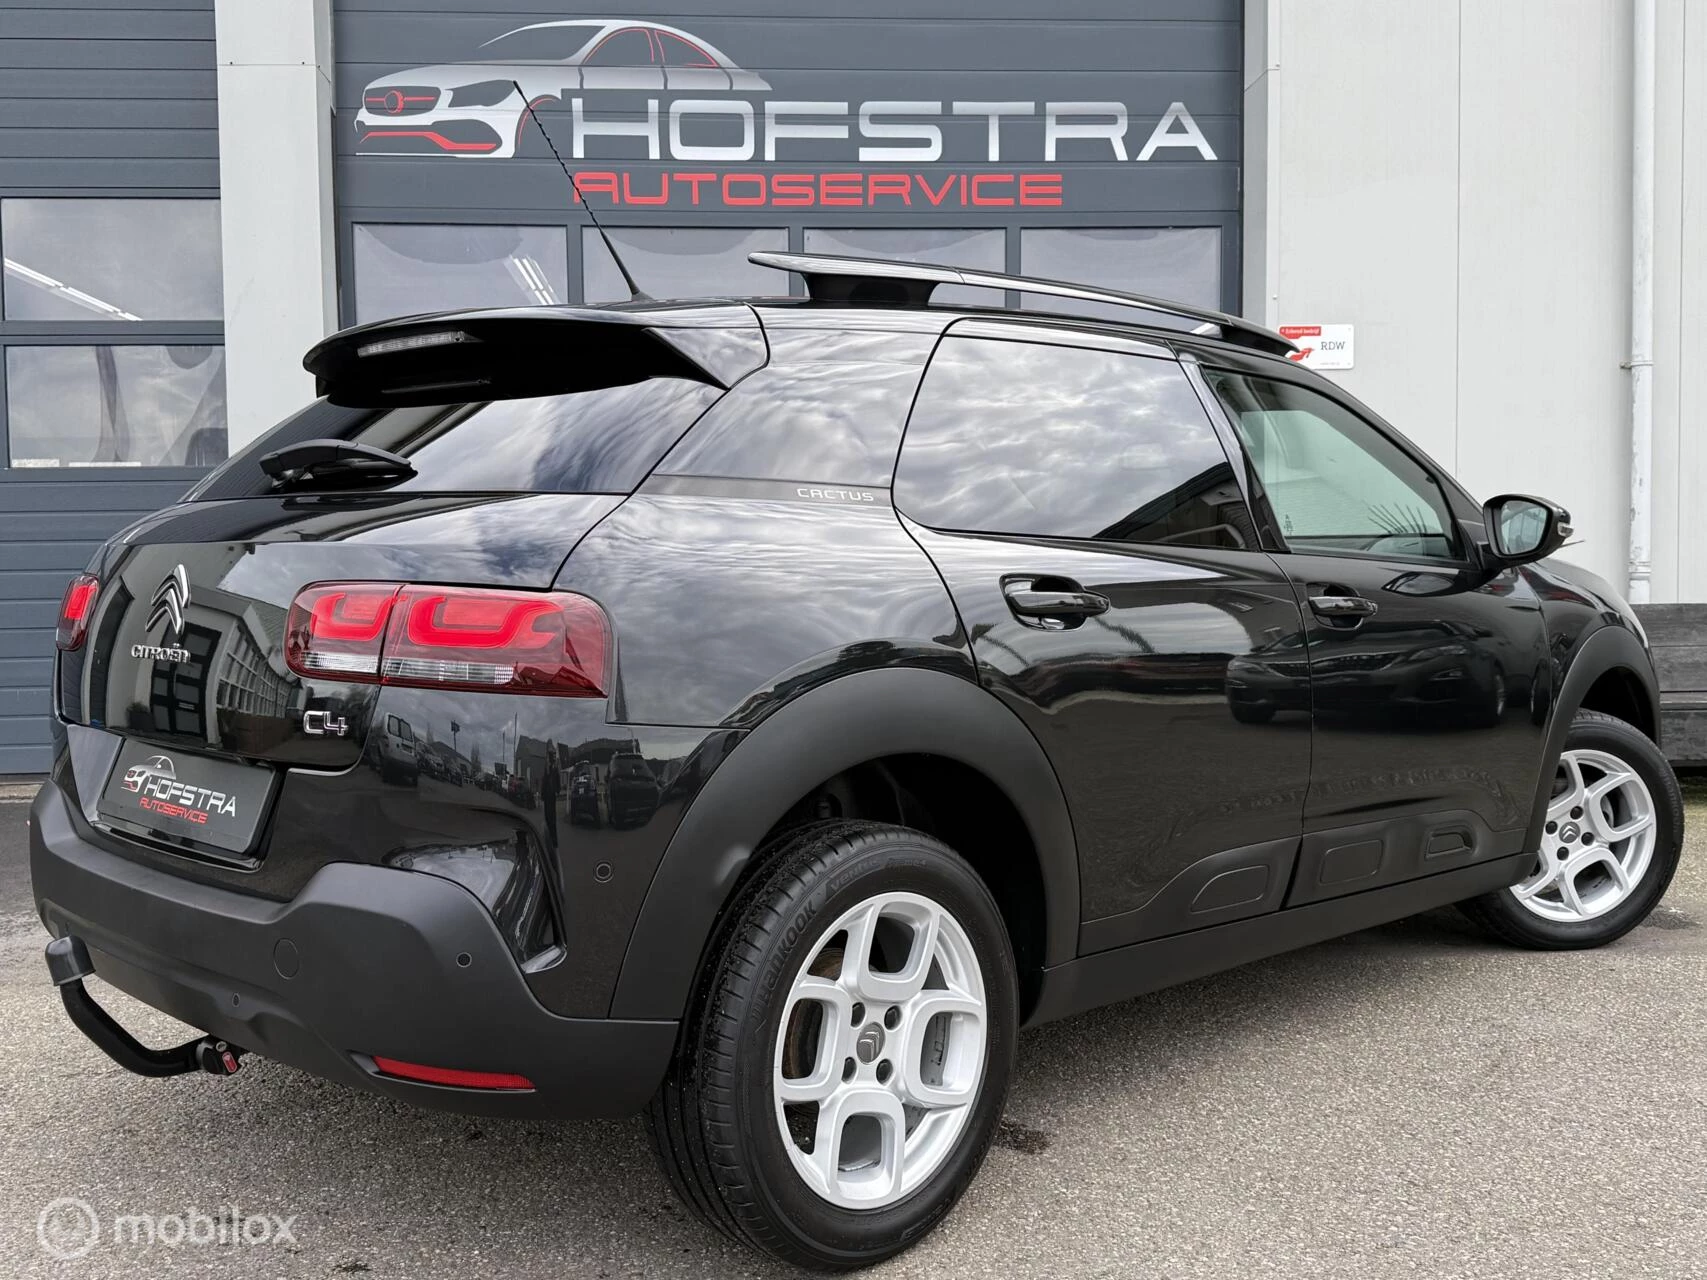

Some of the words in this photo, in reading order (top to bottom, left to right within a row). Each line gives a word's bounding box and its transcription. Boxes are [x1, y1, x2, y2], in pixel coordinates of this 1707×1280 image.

[571, 98, 1218, 161] HOFSTRA
[573, 172, 1063, 206] AUTOSERVICE
[1320, 341, 1346, 351] RDW
[796, 488, 874, 502] CACTUS
[303, 710, 349, 736] C4
[143, 776, 236, 817] HOFSTRA
[140, 797, 208, 823] AUTOSERVICE
